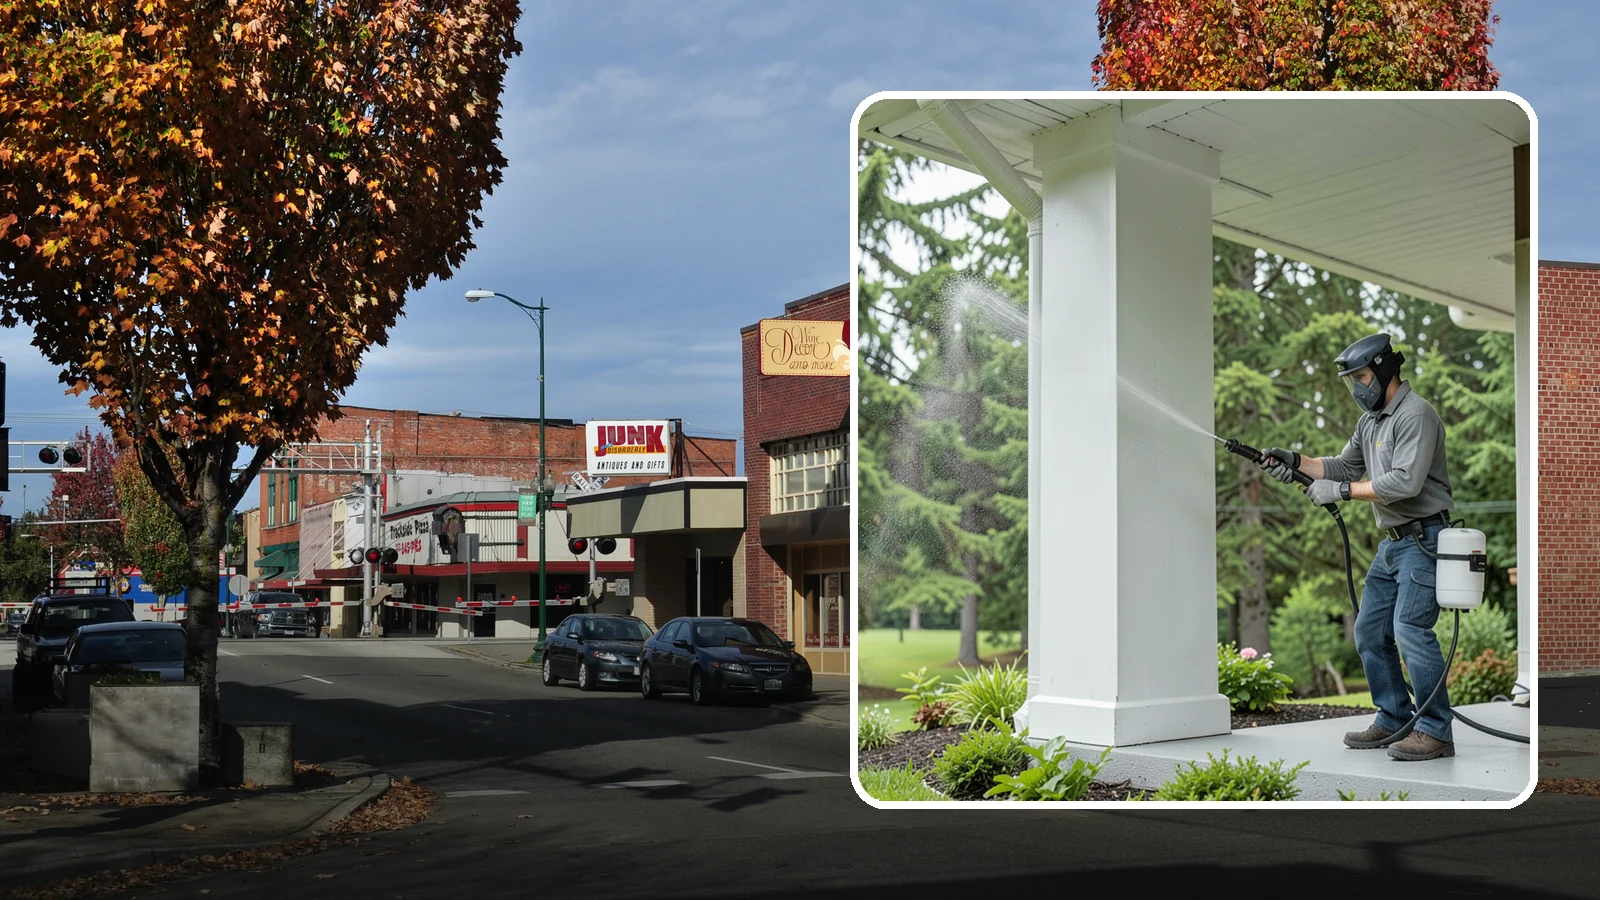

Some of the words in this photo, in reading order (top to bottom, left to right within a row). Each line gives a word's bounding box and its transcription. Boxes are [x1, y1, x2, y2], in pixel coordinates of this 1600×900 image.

[596, 425, 664, 457] JUNK
[607, 446, 646, 454] DISORDERLY
[597, 461, 628, 470] ANTIQUES
[631, 461, 643, 470] AND
[647, 460, 665, 470] GIFTS
[590, 476, 609, 492] SING
[390, 522, 413, 540] Trackside
[415, 519, 429, 535] Pizza
